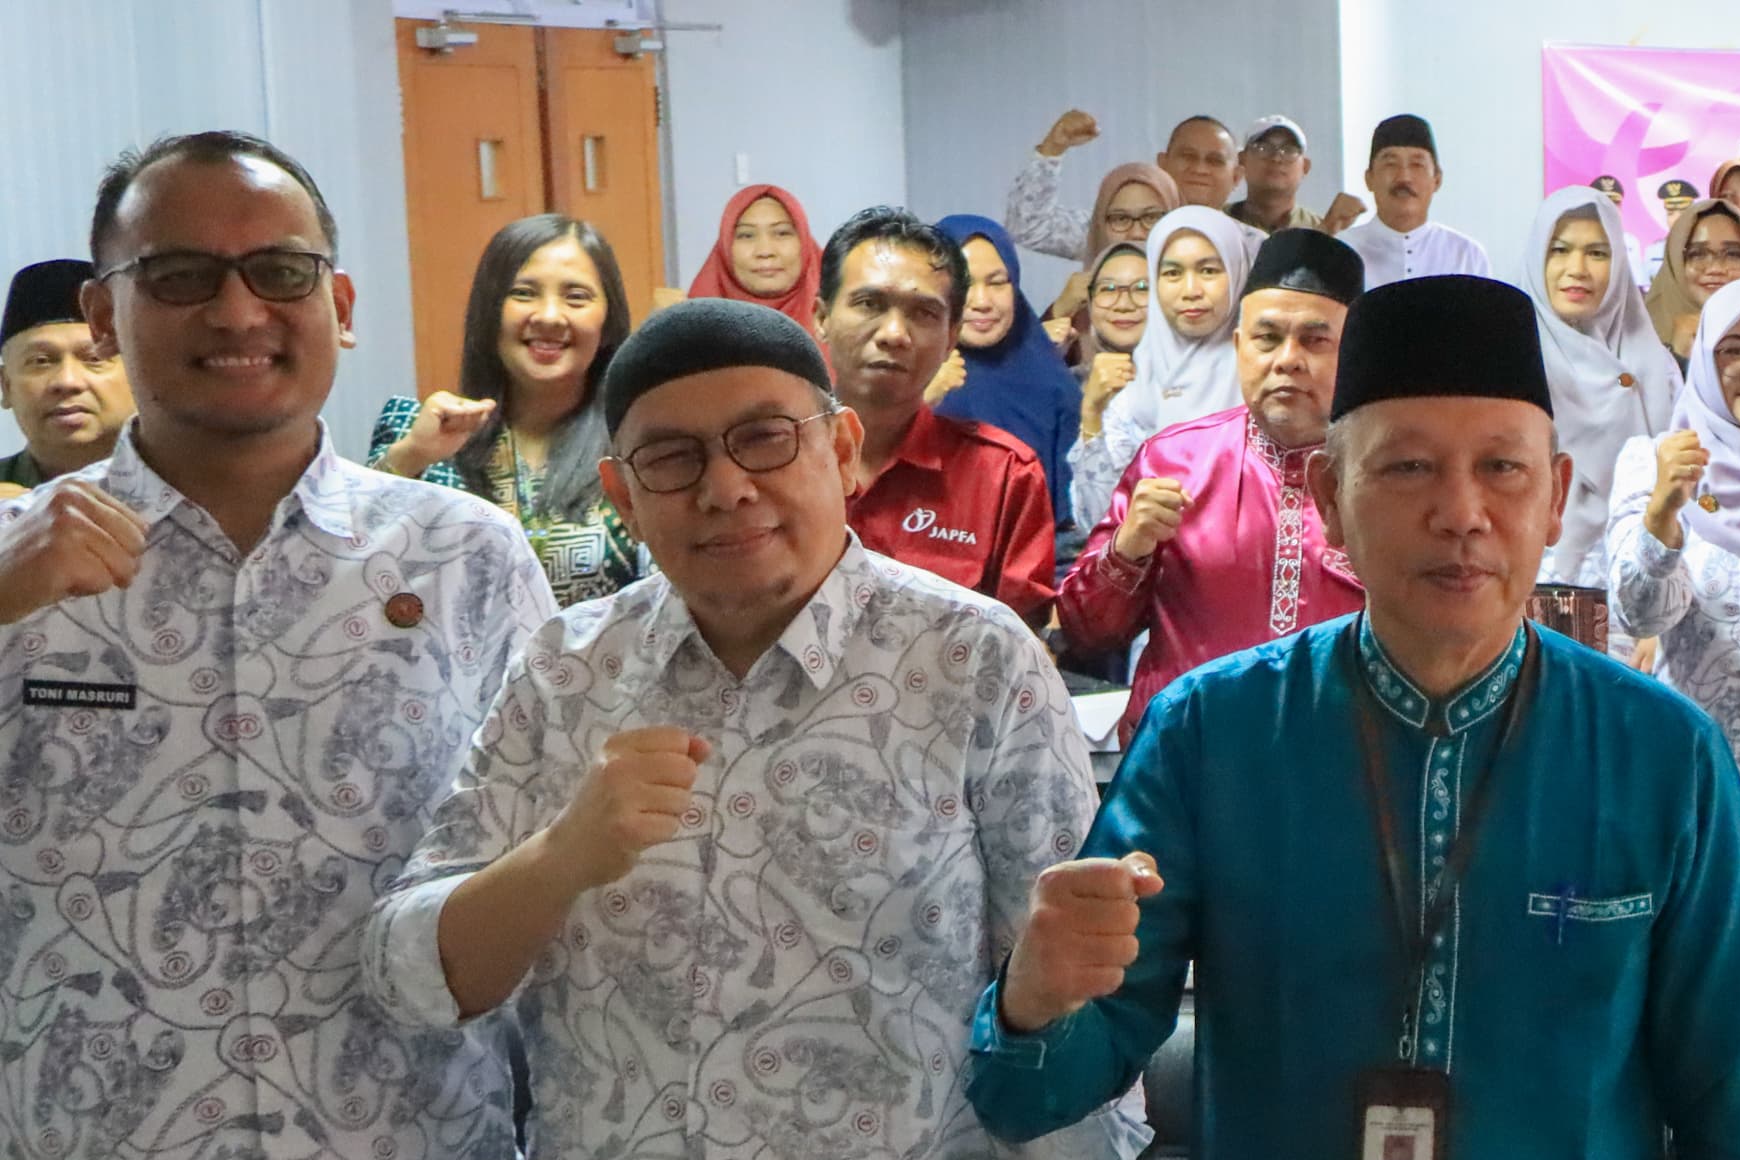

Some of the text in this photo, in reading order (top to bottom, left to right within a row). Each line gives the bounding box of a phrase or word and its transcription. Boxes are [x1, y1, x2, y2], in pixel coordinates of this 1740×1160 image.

[928, 526, 977, 545] JAPFA
[29, 687, 130, 704] TONI MASRURI
